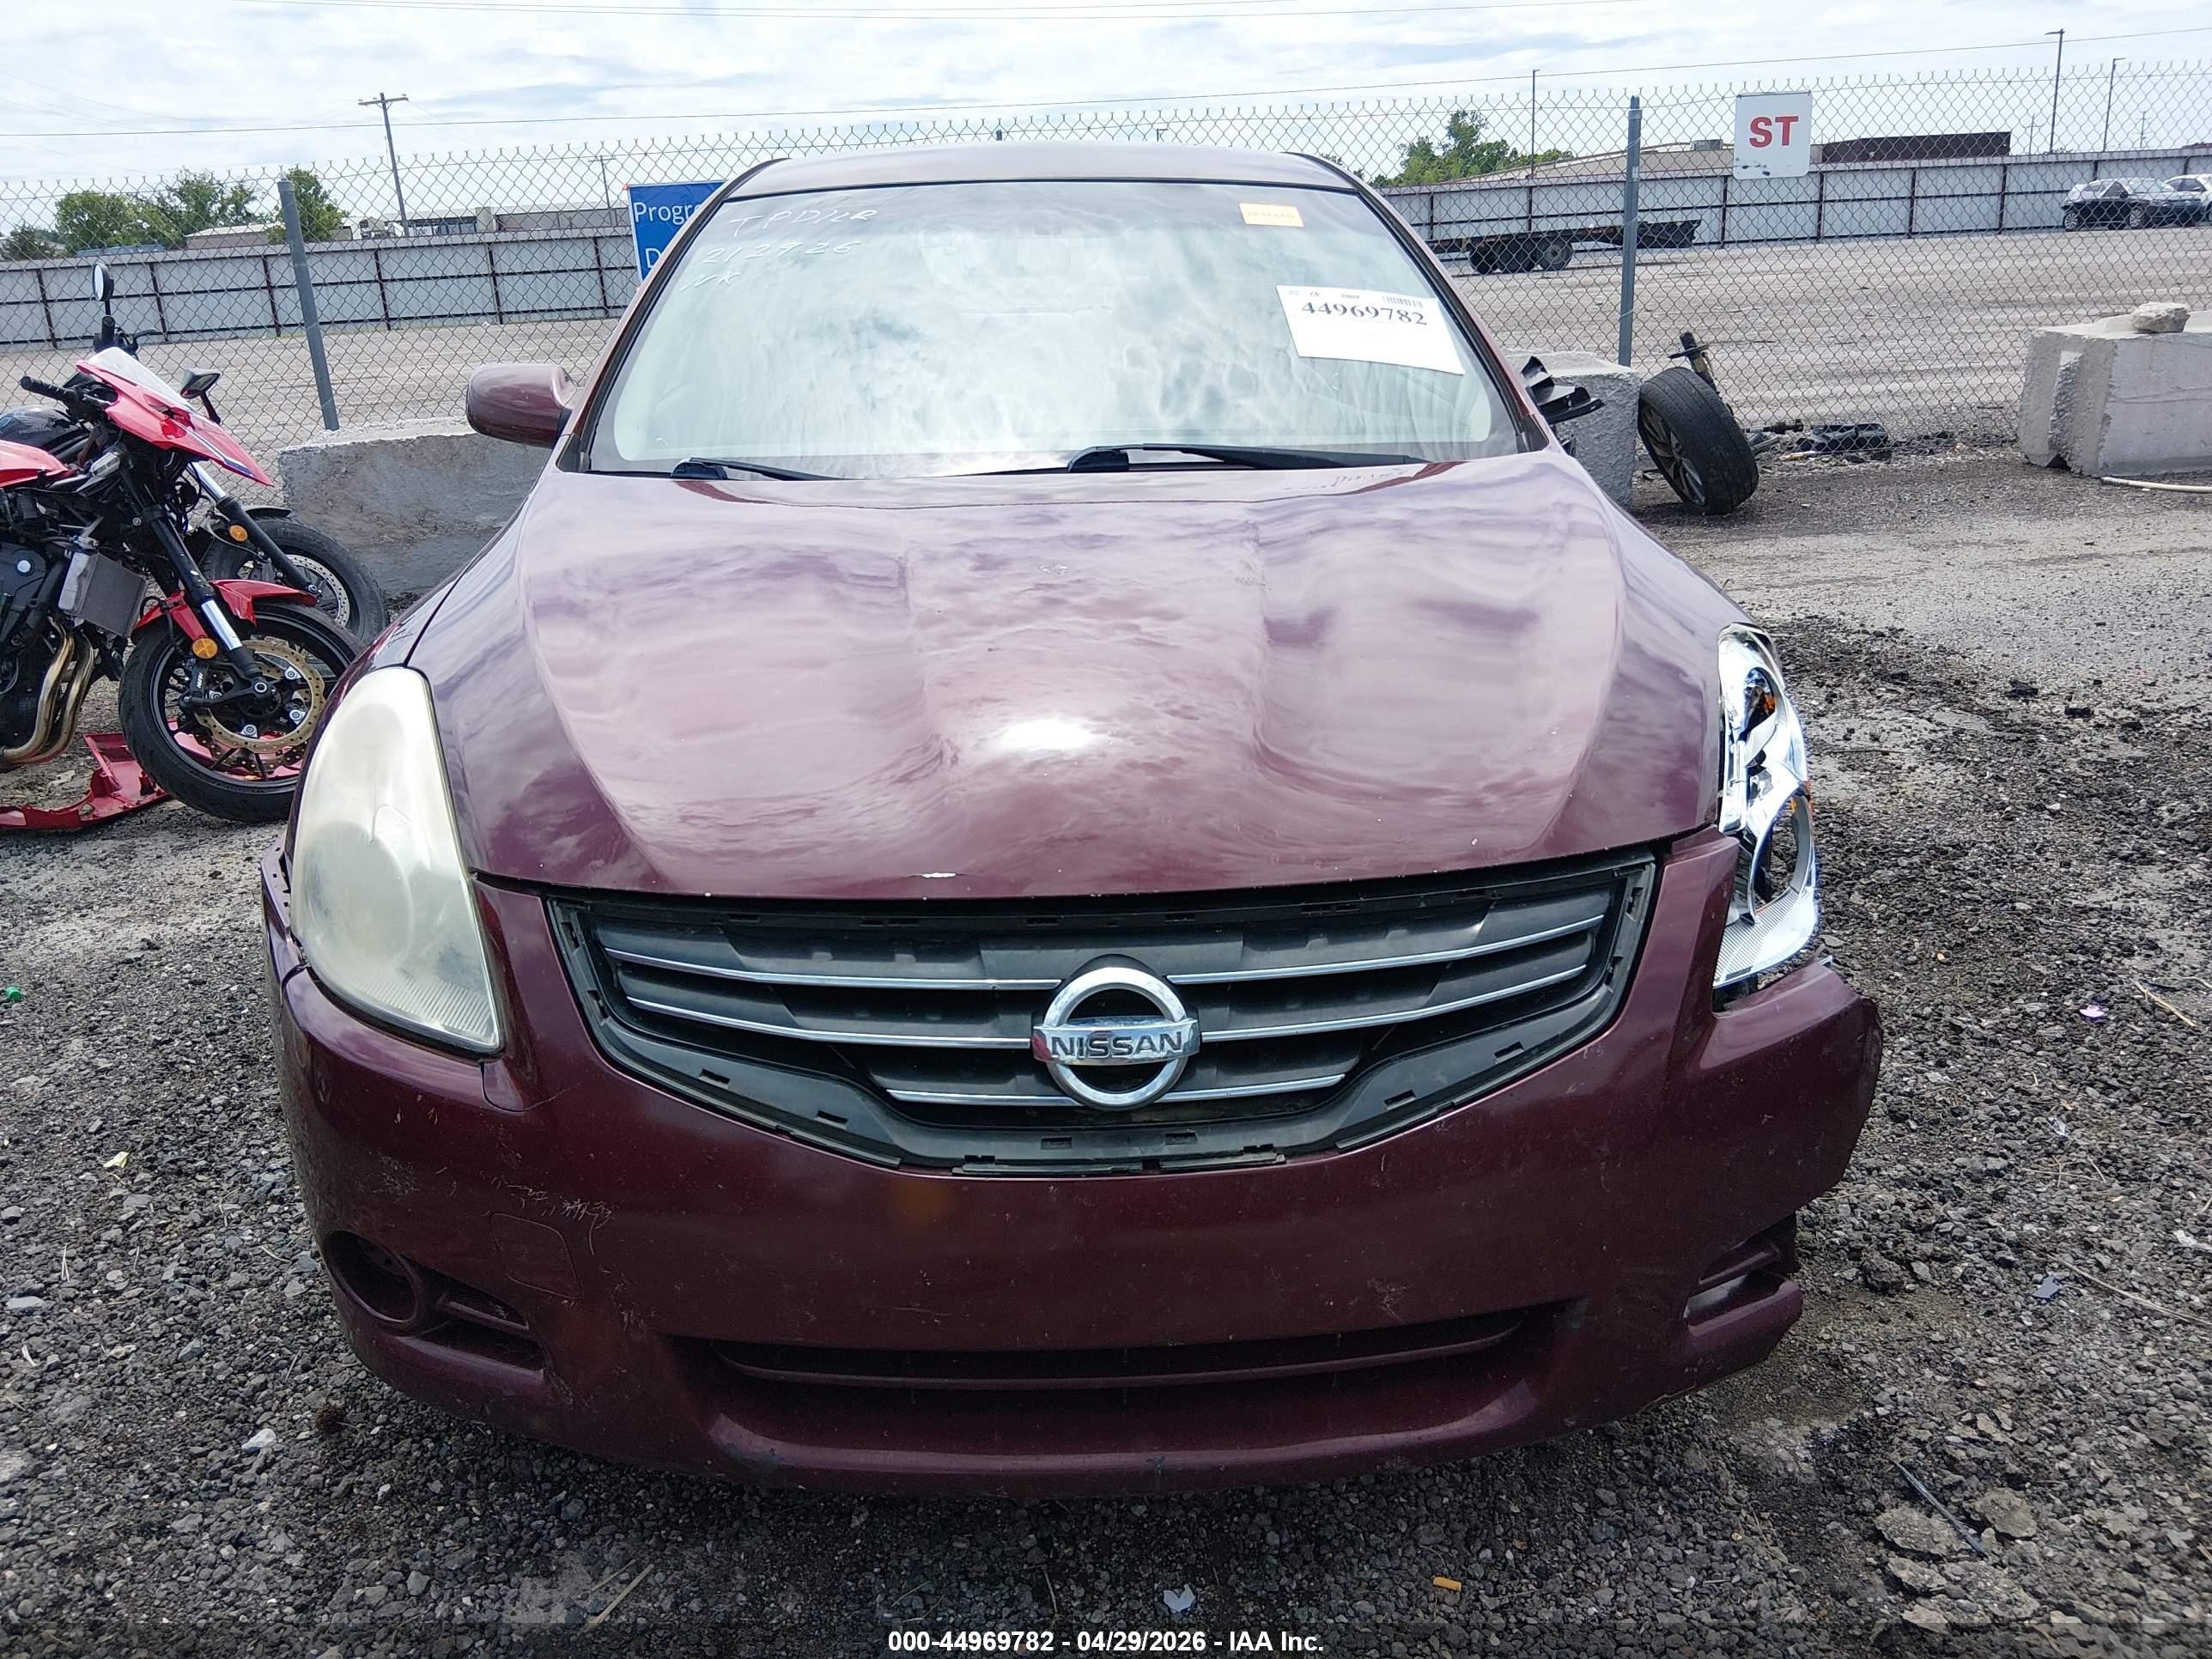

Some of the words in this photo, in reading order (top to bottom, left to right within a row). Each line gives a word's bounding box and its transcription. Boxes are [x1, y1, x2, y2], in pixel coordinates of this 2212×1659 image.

[1748, 115, 1800, 149] ST
[1301, 301, 1428, 326] 44969782
[1050, 1030, 1183, 1059] NISSAN
